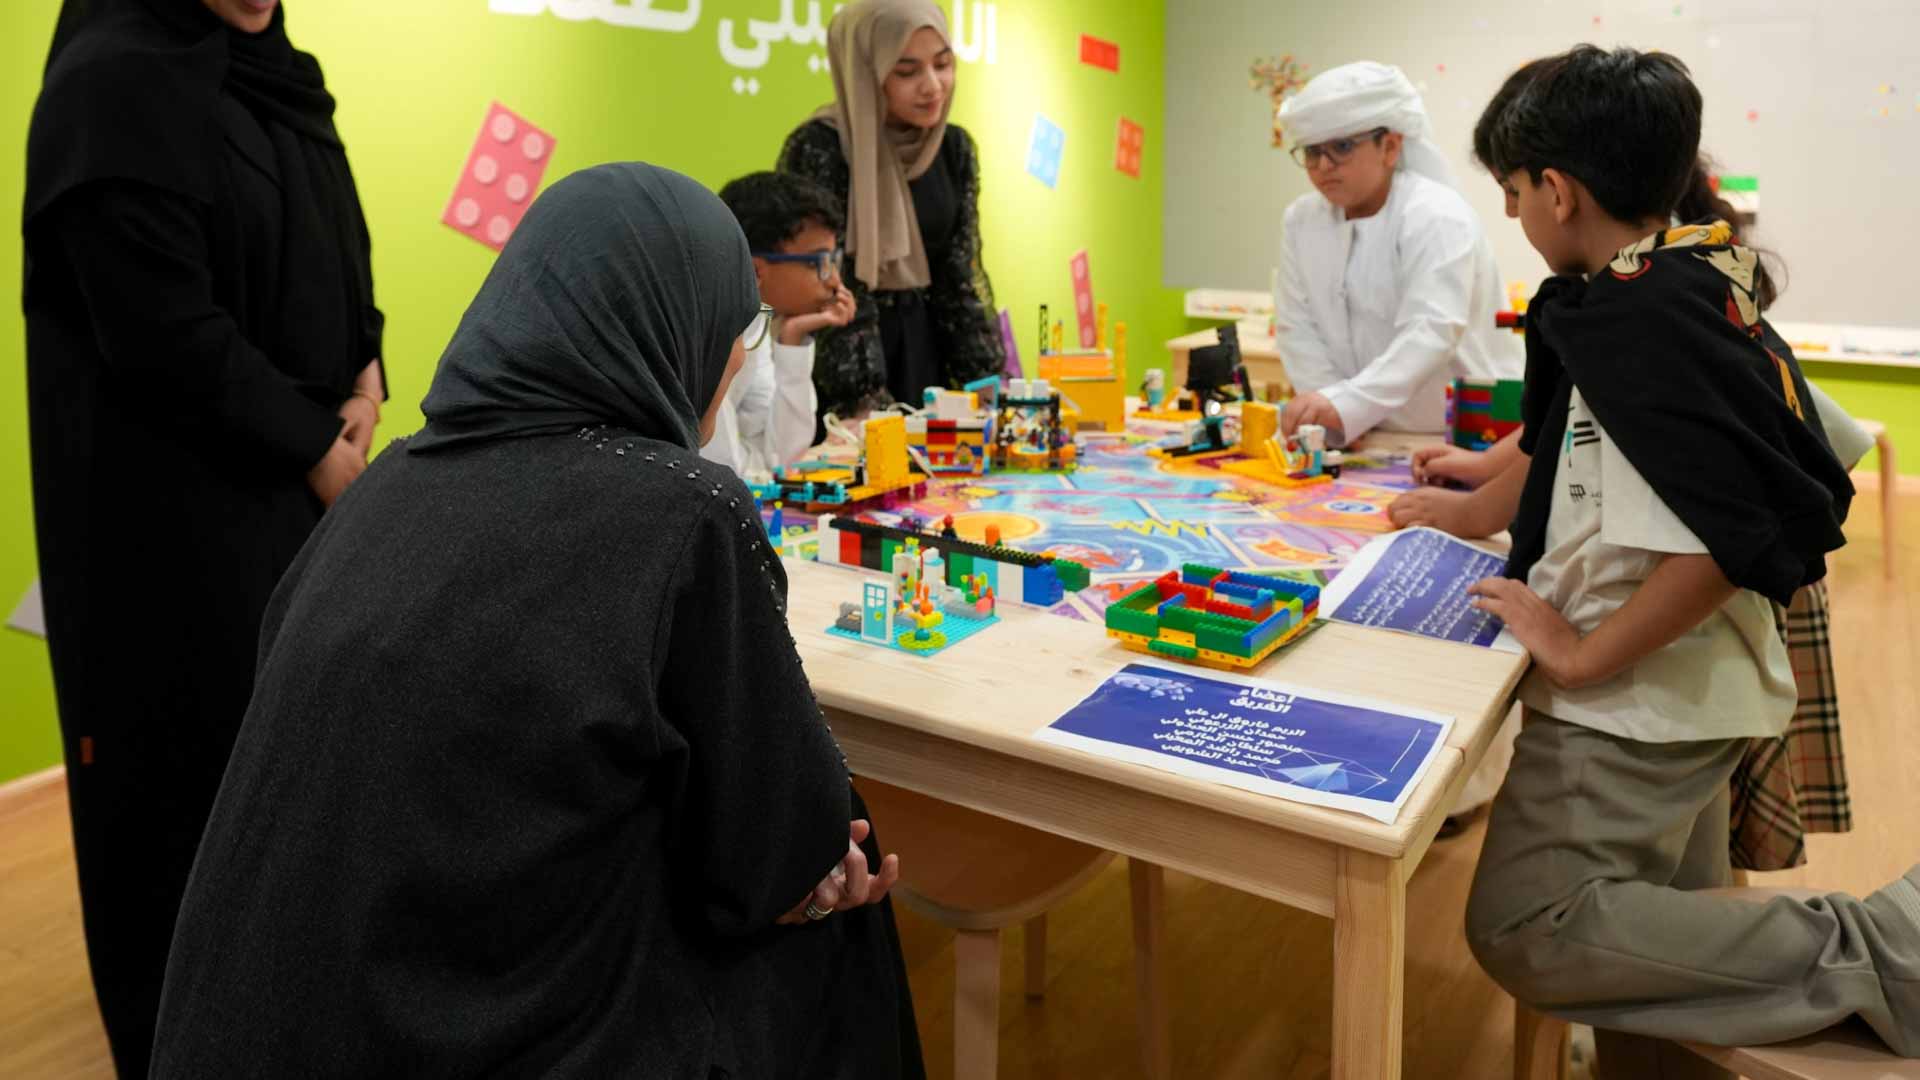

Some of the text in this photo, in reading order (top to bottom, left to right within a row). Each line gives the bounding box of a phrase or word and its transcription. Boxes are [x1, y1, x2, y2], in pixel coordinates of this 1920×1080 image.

[1230, 695, 1291, 713] الفريق
[1229, 717, 1269, 728] فاروق
[1218, 731, 1254, 741] حسن
[1244, 729, 1286, 740] حمدان
[1206, 745, 1241, 757] راشد
[1227, 741, 1274, 755] سلطان
[1256, 740, 1302, 752] منصور
[1224, 757, 1257, 767] حميد
[1243, 753, 1281, 765] محمد
